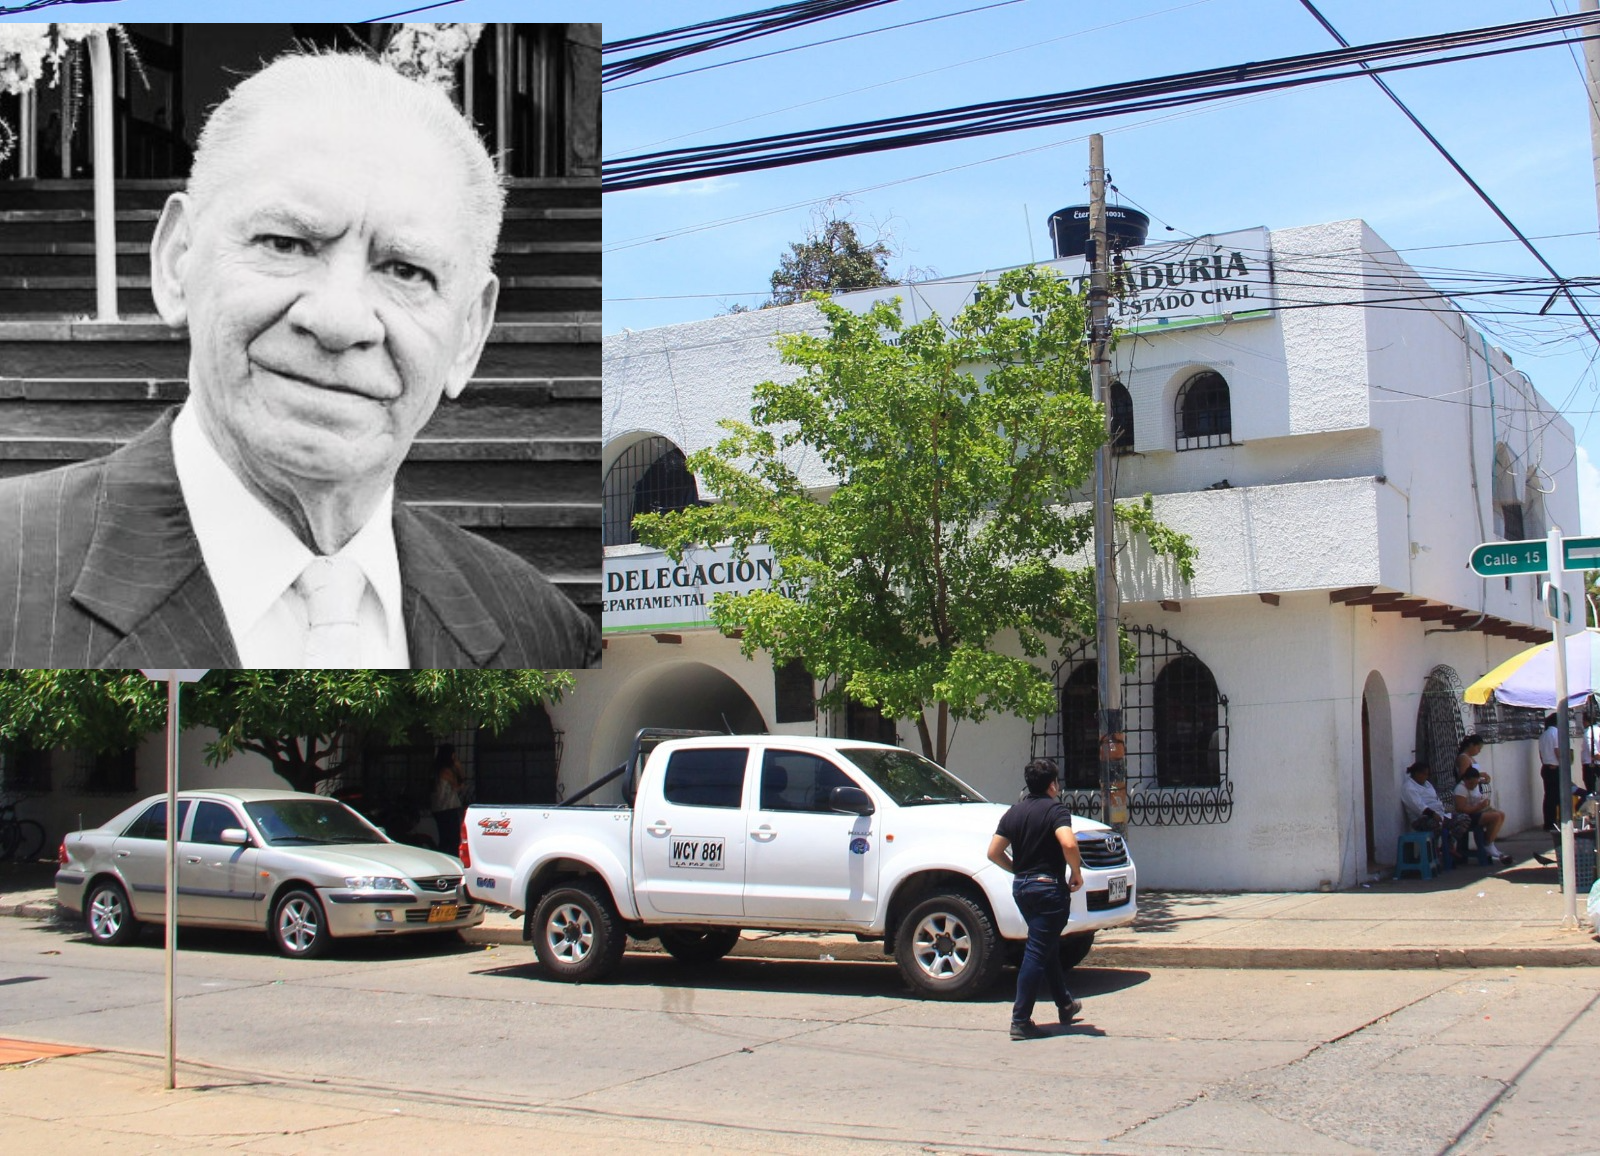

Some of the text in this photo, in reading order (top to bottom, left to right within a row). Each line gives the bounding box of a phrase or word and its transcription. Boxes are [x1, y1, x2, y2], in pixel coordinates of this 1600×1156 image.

[1118, 284, 1255, 317] ESTADO CIVIL
[1483, 551, 1541, 567] Calle 15
[607, 552, 773, 593] DELEGACIÓN
[602, 593, 706, 613] EPARTAMENTAL
[673, 841, 723, 862] WCY 881
